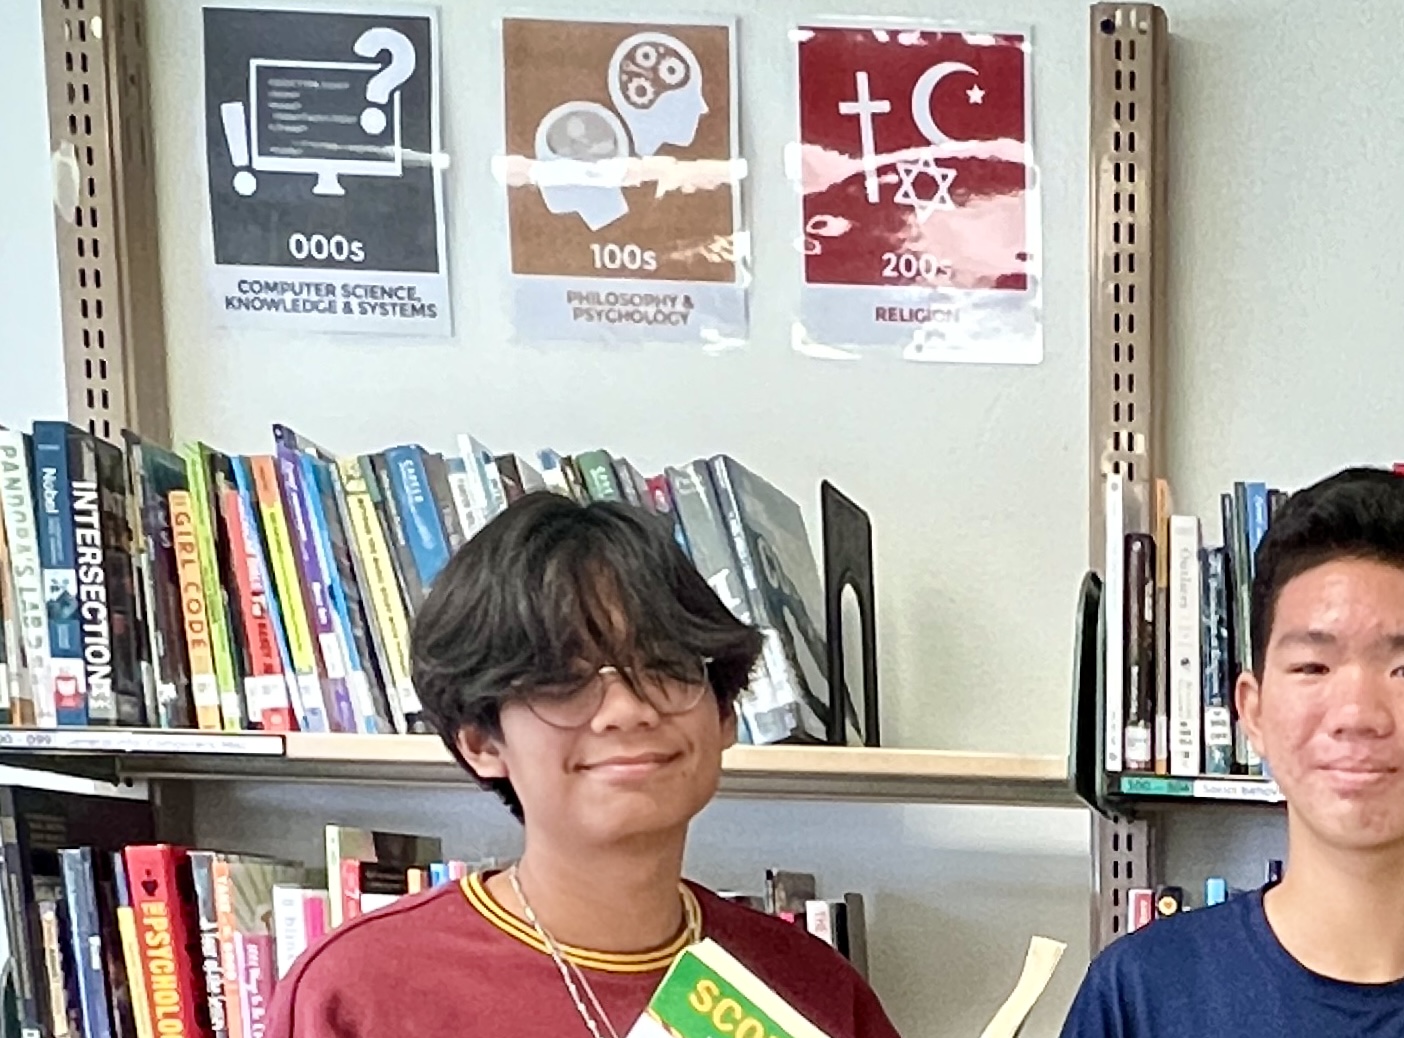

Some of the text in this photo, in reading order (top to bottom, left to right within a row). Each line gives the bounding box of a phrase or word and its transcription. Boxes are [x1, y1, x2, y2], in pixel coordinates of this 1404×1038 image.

[288, 232, 366, 262] 000s
[589, 243, 658, 271] 100s
[237, 279, 422, 302] COMPUTER SCIENCE,
[567, 289, 694, 309] PHILOSOPHY &
[225, 296, 438, 318] KNOWLEDGE & SYSTEMS
[573, 307, 690, 326] PSYCHOLOGY
[1, 444, 35, 579] PANDORA'S
[174, 511, 208, 649] GIRL CODE
